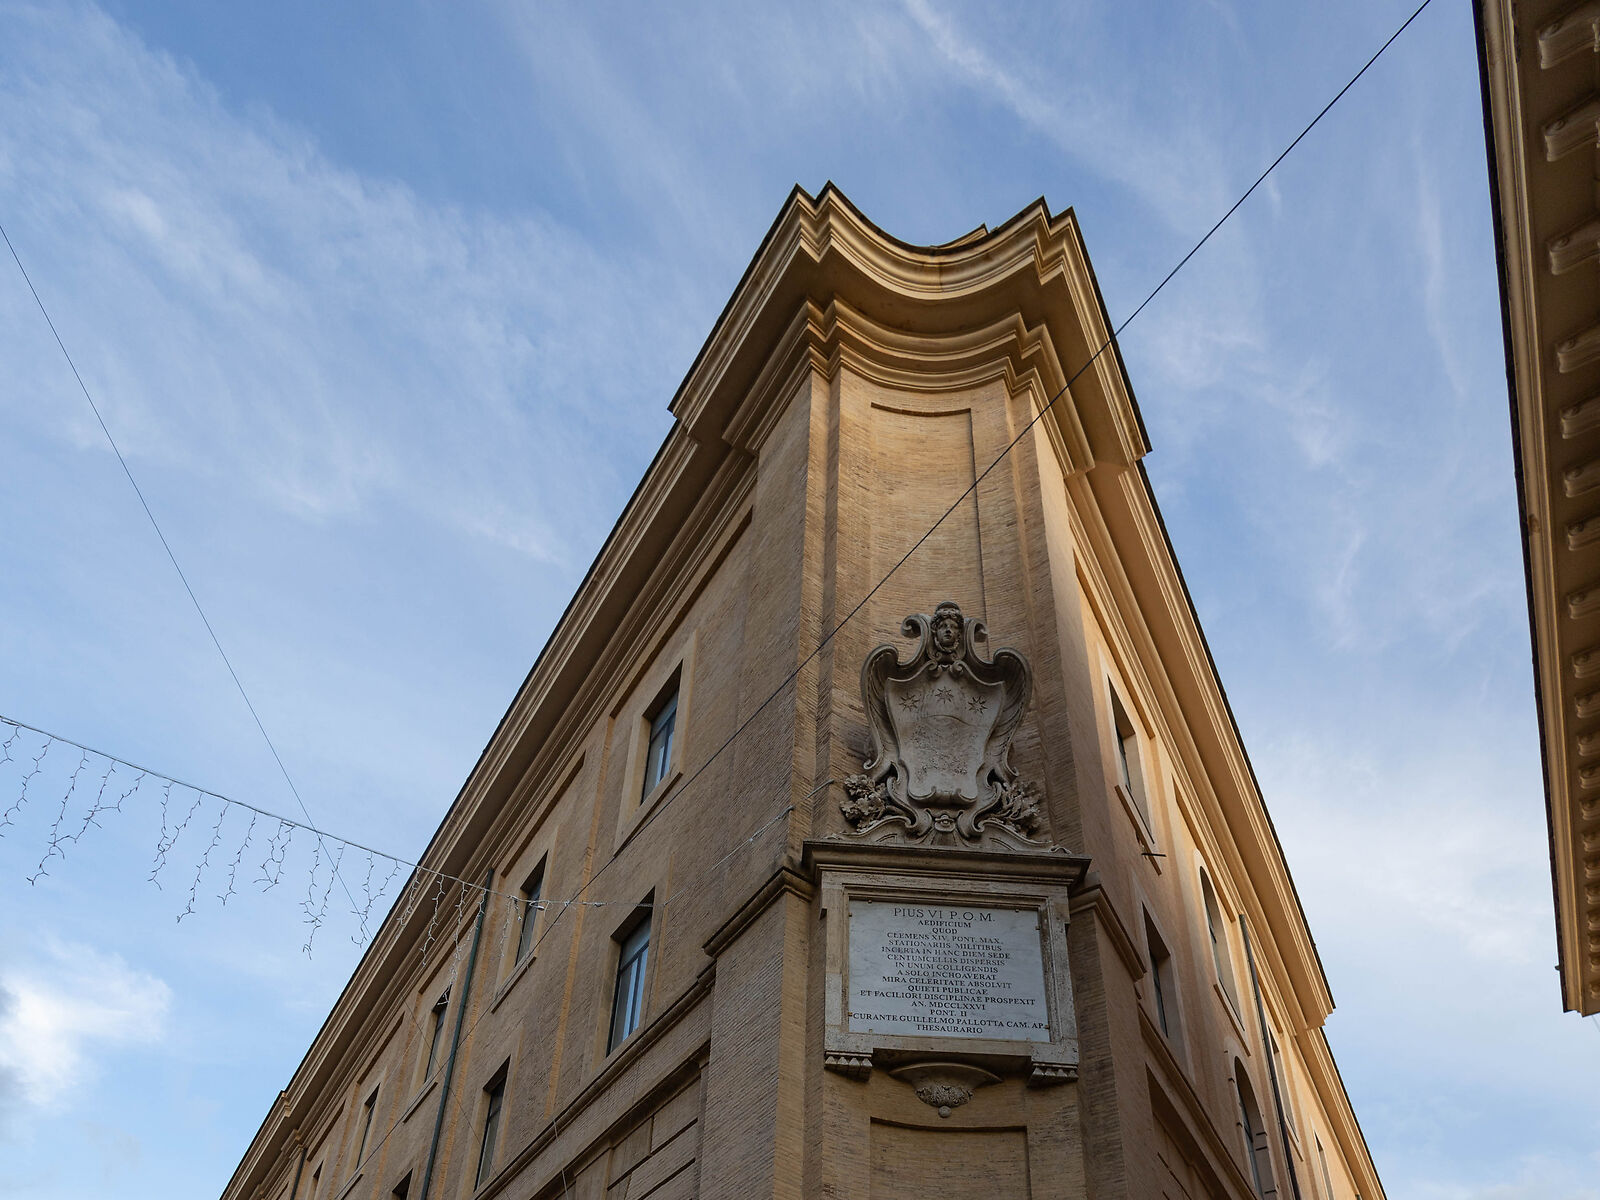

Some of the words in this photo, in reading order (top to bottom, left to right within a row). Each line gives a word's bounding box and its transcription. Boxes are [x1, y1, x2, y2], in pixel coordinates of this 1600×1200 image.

[894, 908, 924, 918] PIUS
[928, 910, 942, 919] VI
[918, 920, 971, 928] AEDIFICIUM
[887, 932, 929, 940] CLEMENS
[881, 946, 920, 954] INCERTA
[955, 943, 1002, 951] MILITIBUS
[960, 958, 1005, 966] DISPERSIS
[936, 964, 998, 973] COLLIGENDIS
[932, 972, 996, 980] INCHOAVERAT
[909, 978, 965, 986] CELERITATE
[967, 980, 1012, 989] ABSOLVIT
[942, 987, 988, 995] PUBLICAE
[874, 991, 921, 999] FACILIORI
[924, 993, 982, 1002] DISCIPLINAE
[985, 996, 1036, 1006] PROSPEXIT
[929, 1001, 986, 1010] MDCCLXXVI
[853, 1012, 898, 1021] CURANTE
[900, 1015, 954, 1024] GUILLELMO
[957, 1018, 1004, 1027] PALLOTTA
[917, 1024, 983, 1033] THESAURARIO
